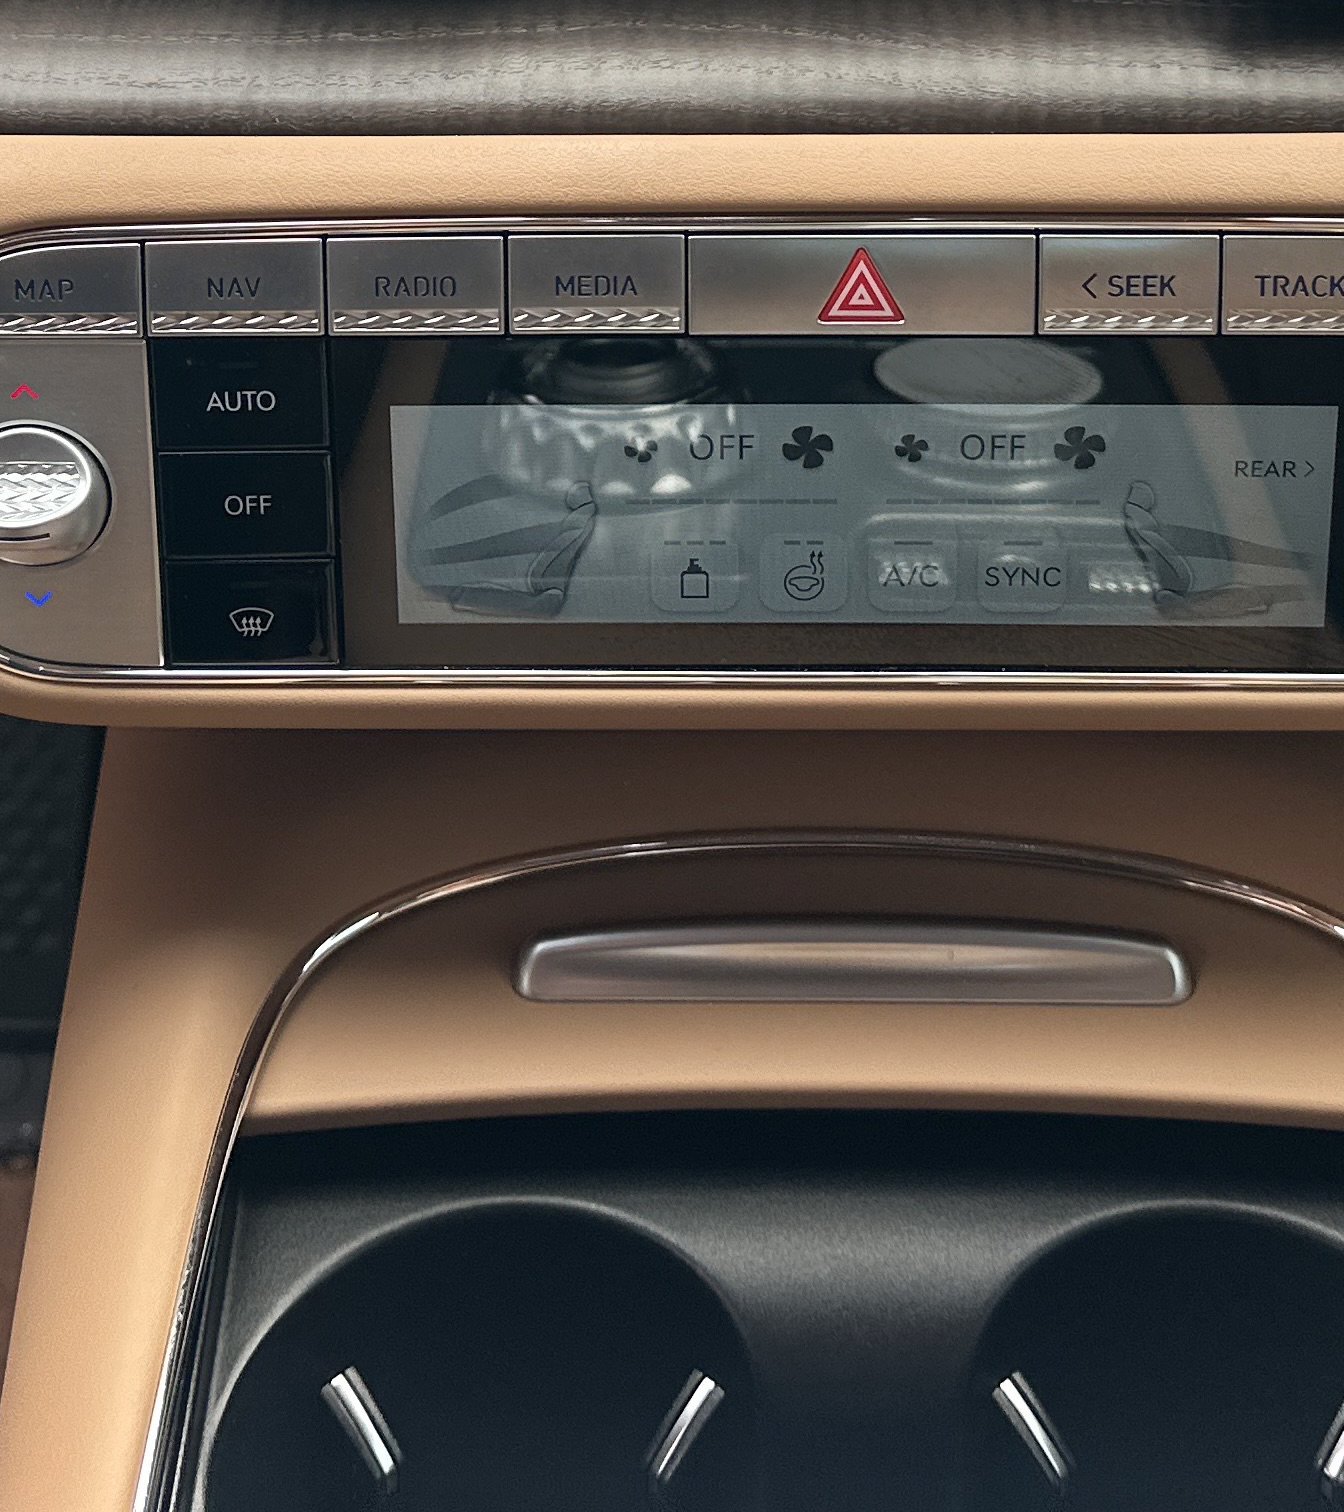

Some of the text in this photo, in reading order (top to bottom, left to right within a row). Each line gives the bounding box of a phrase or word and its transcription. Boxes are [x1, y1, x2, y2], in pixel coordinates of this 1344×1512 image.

[14, 278, 74, 300] MAP
[206, 276, 261, 298] NAV
[374, 275, 457, 298] RADIO
[555, 274, 638, 297] MEDIA
[1107, 274, 1177, 298] SEEK
[206, 390, 276, 412] AUTO
[689, 433, 755, 461] OFF
[960, 433, 1027, 461] OFF
[1234, 459, 1297, 478] REAR
[224, 494, 272, 516] OFF
[882, 564, 939, 588] A/C
[984, 566, 1062, 588] SYNC
